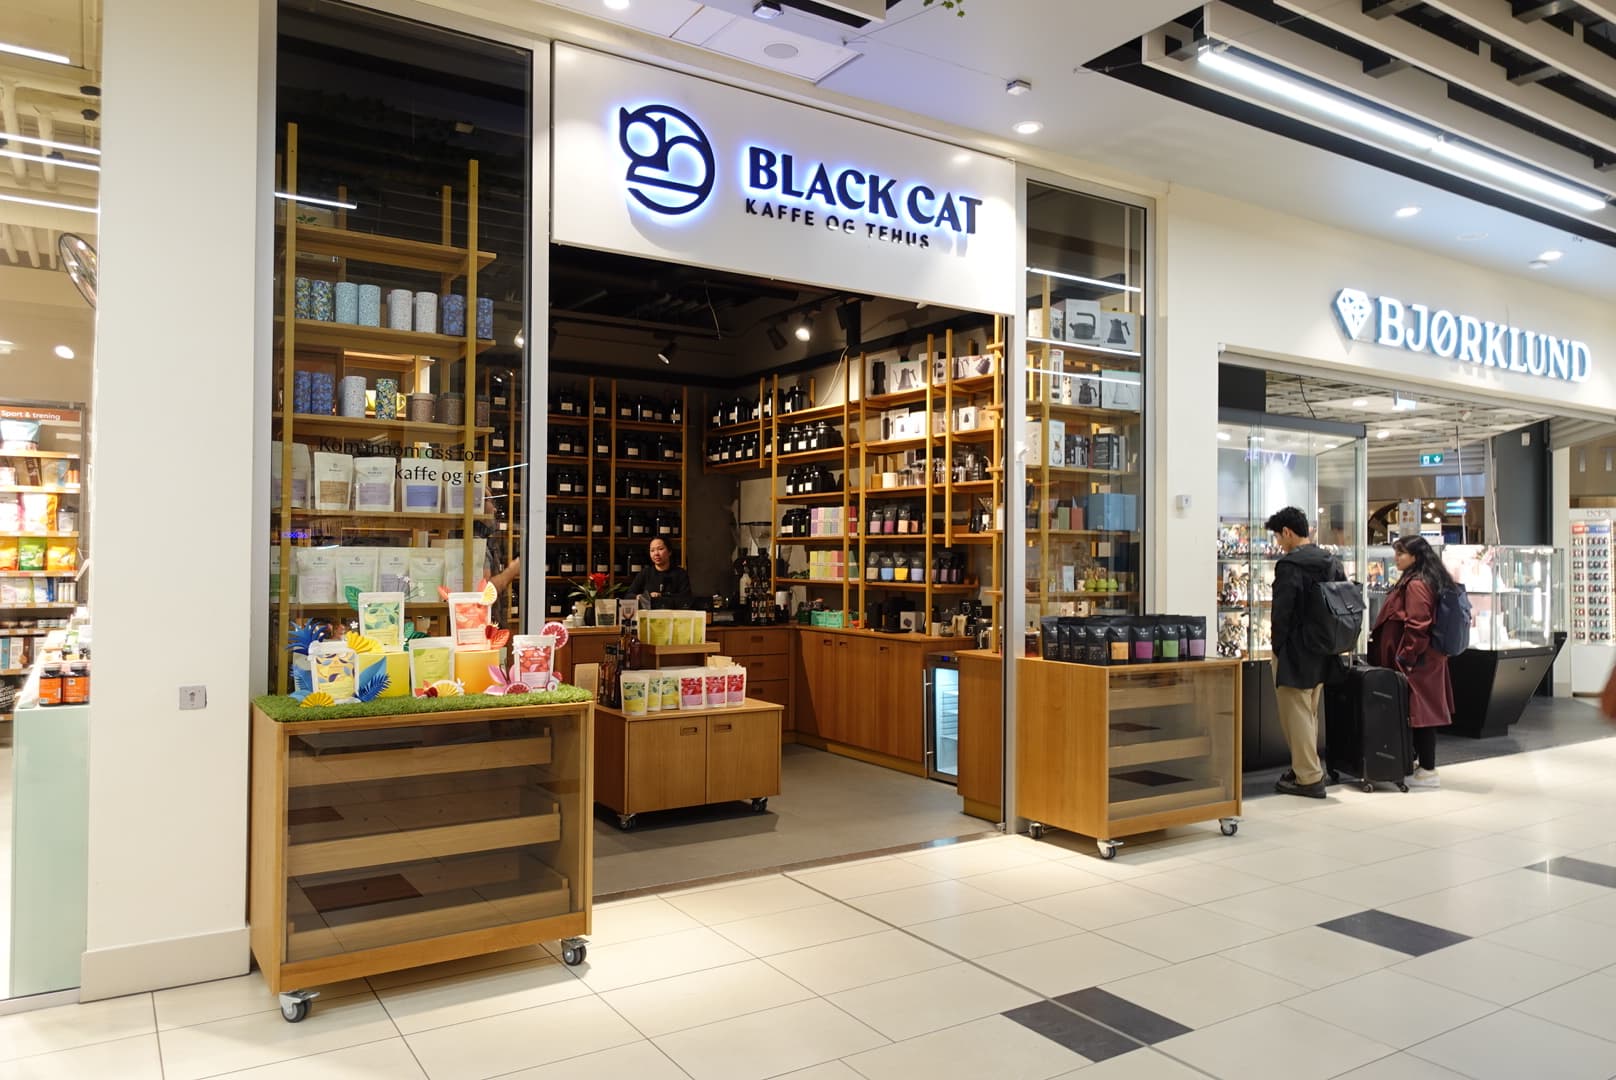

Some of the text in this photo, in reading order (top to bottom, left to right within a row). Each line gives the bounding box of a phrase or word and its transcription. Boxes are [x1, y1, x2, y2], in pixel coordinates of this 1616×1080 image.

[748, 146, 983, 235] BLACK CAT
[745, 198, 930, 248] KAFFE OG TEHUS
[1375, 295, 1592, 383] BJØRKLUND
[1, 410, 23, 418] Sport
[32, 412, 61, 420] trening
[318, 436, 481, 462] Kom innom oss for
[395, 465, 482, 485] kaffe og te
